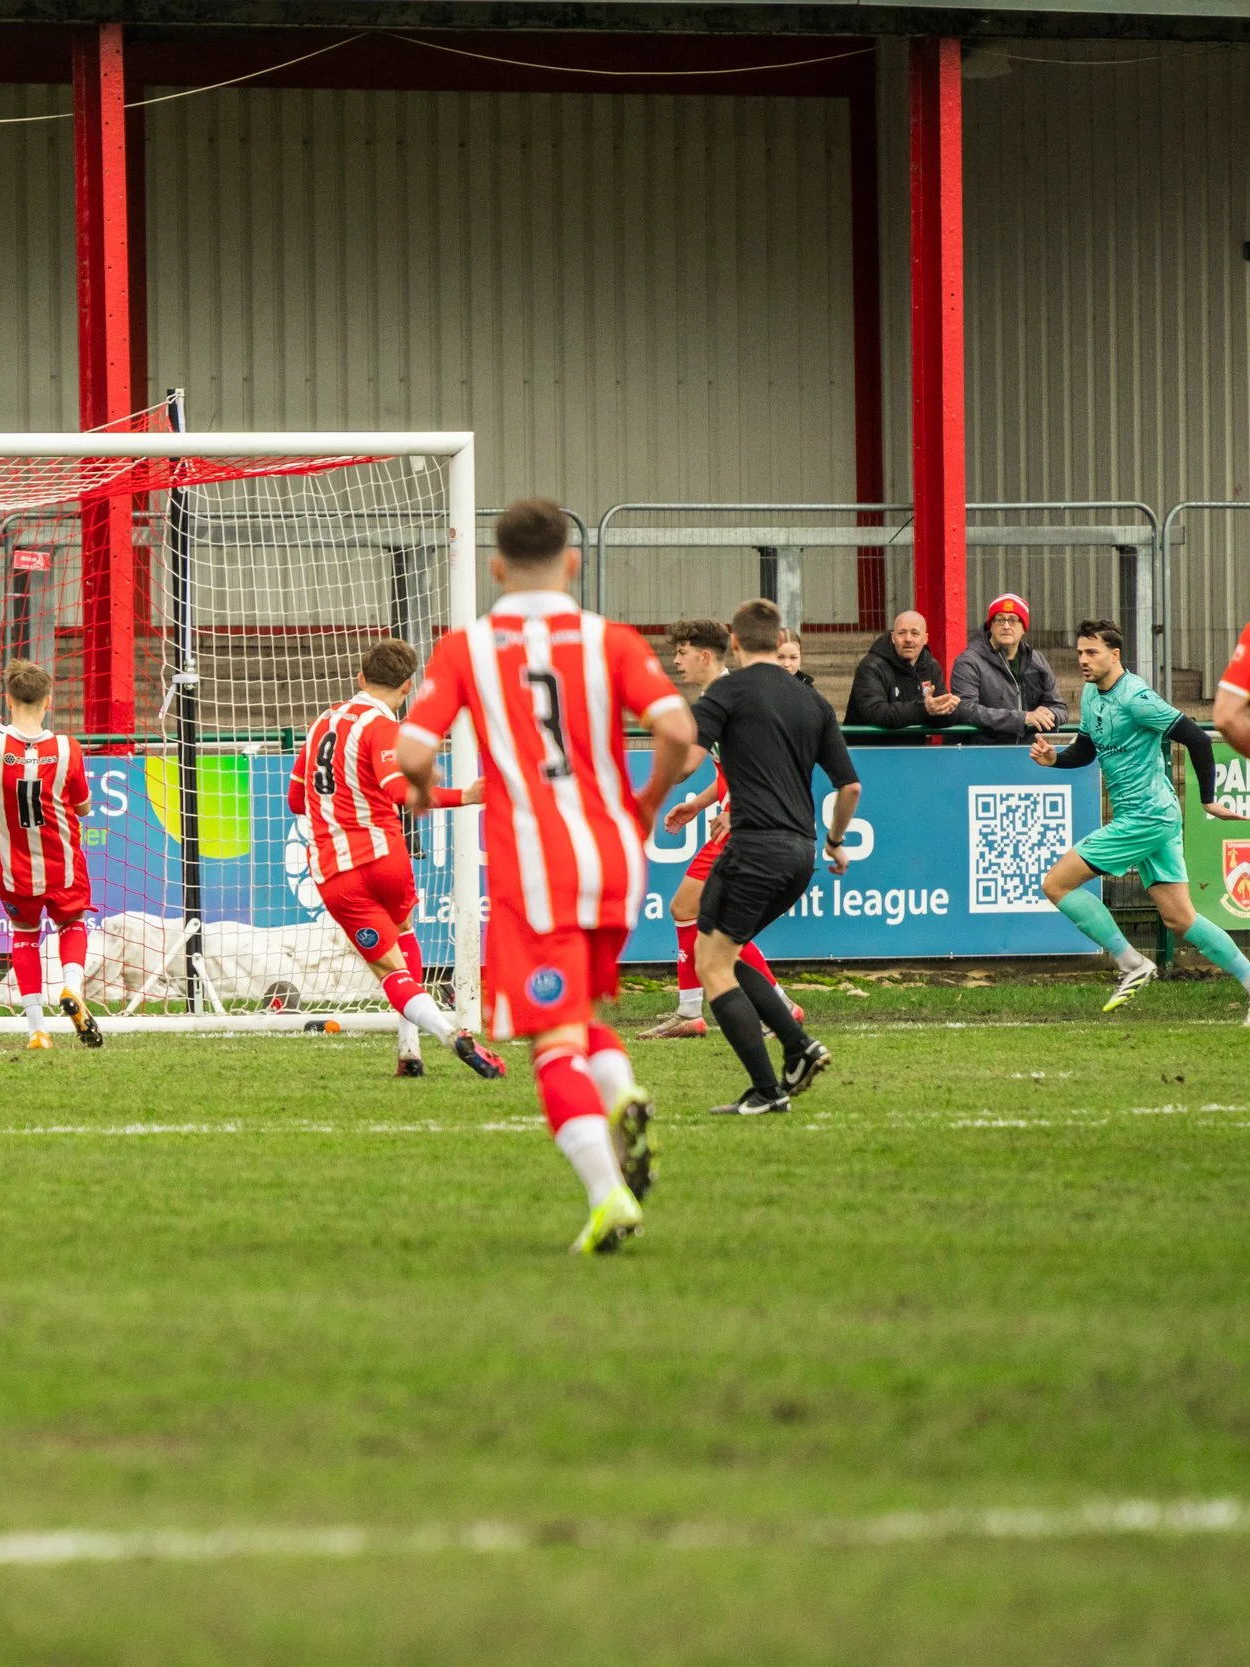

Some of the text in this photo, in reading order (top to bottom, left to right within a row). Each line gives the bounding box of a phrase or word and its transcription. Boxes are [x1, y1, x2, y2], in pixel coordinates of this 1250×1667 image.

[526, 671, 574, 778] 3
[314, 731, 337, 794] 9
[1214, 758, 1250, 792] PA
[16, 778, 45, 828] 11
[833, 880, 950, 925] league
